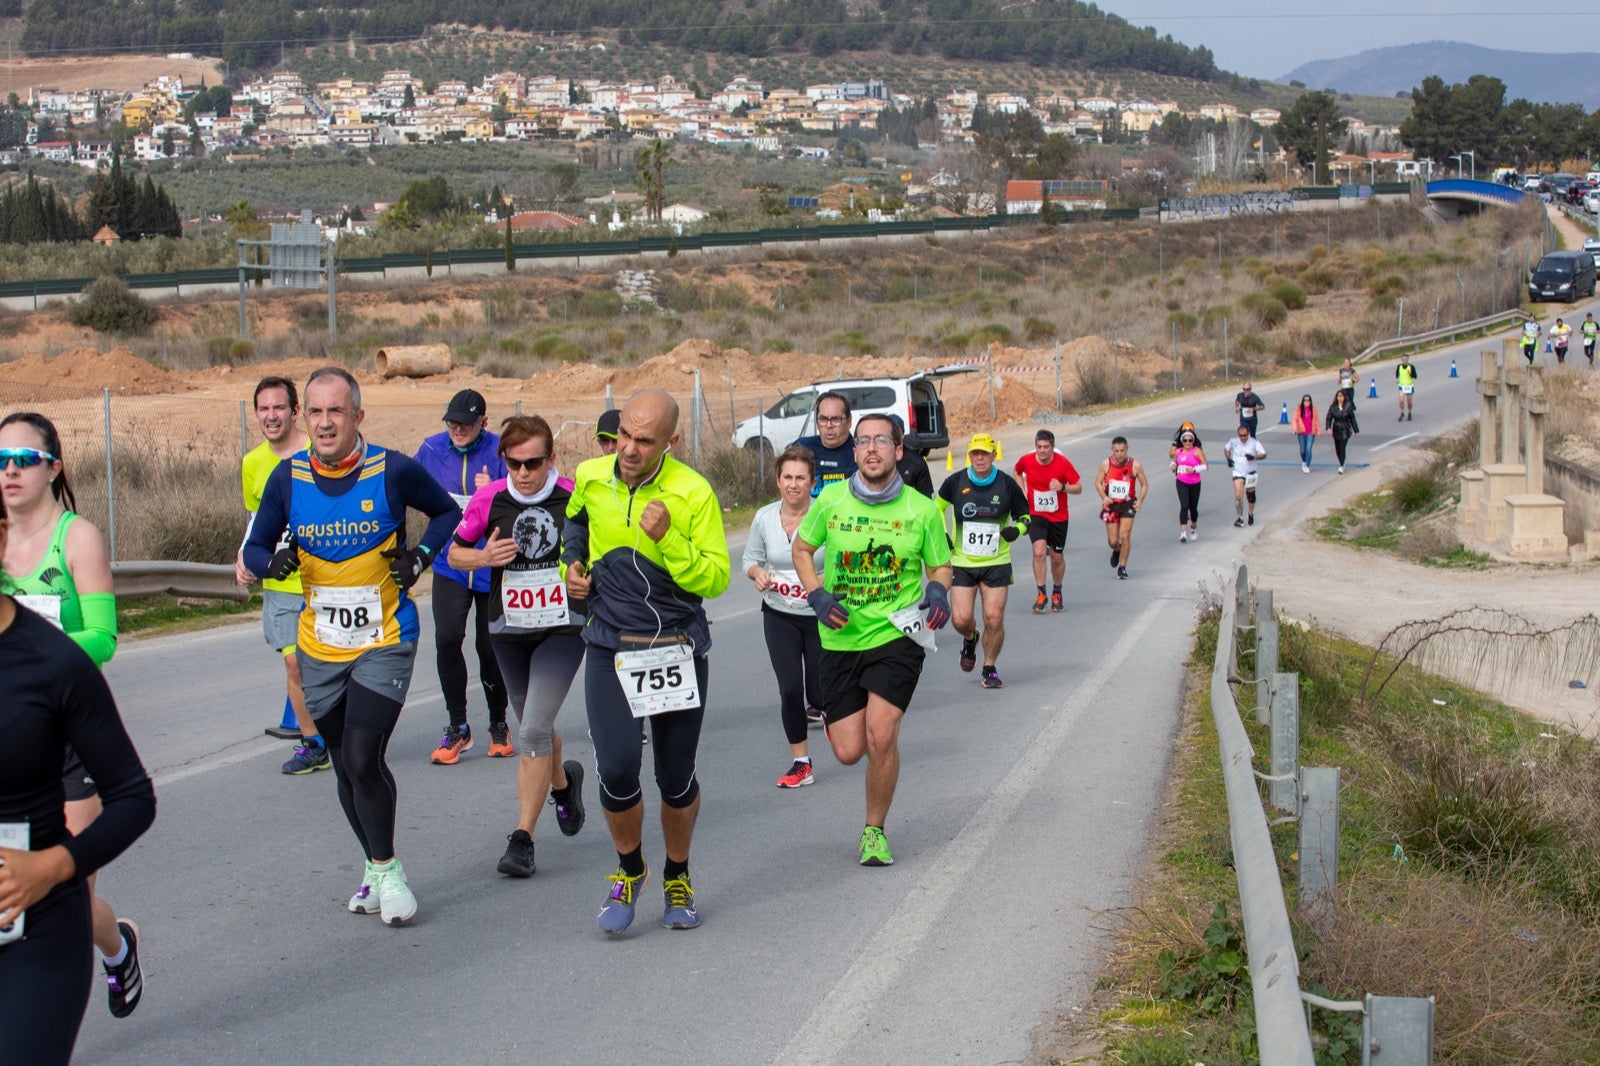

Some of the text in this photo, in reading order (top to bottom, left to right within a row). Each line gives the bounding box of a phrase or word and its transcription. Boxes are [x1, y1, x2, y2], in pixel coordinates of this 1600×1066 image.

[1112, 485, 1126, 494] 265
[1038, 497, 1055, 506] 233
[297, 518, 380, 542] agustinos
[968, 532, 994, 546] 817
[309, 537, 367, 547] GRANADA
[506, 585, 564, 609] 2014
[322, 606, 369, 629] 708
[630, 665, 683, 694] 755
